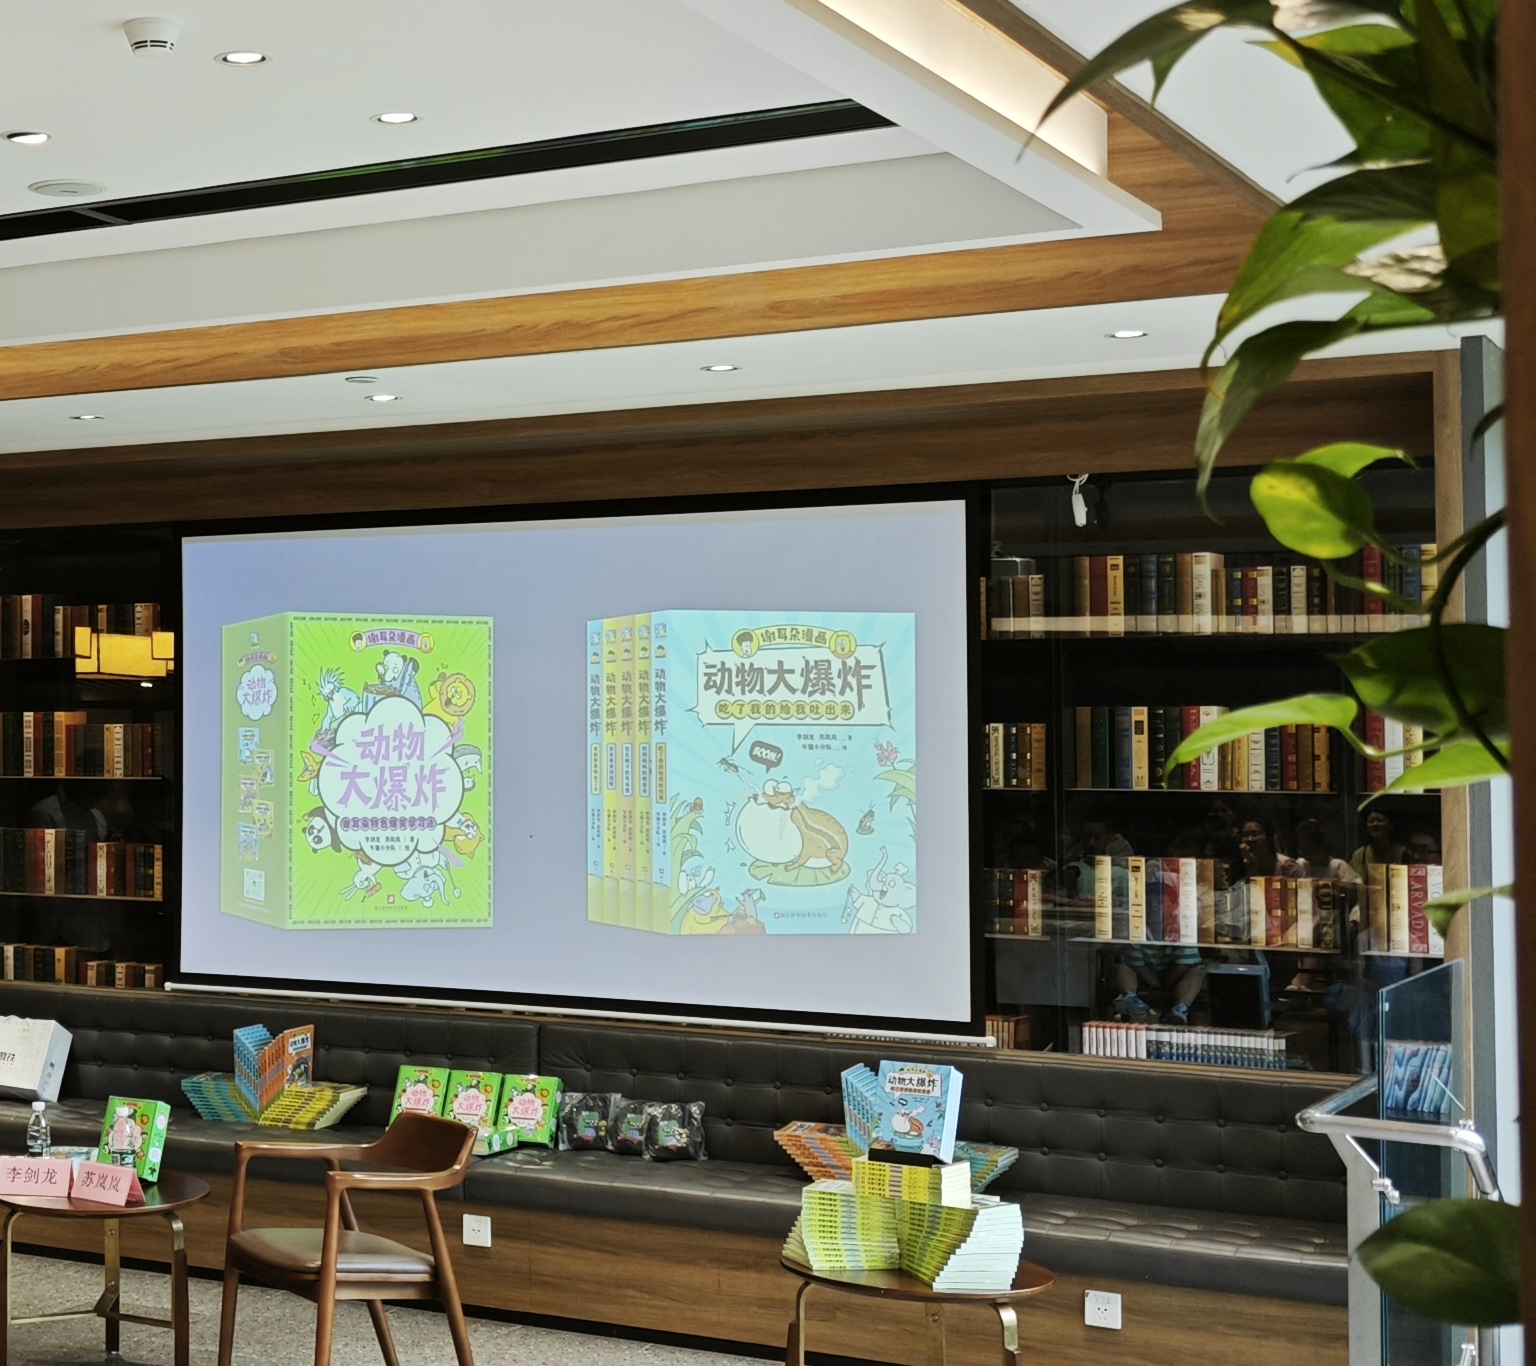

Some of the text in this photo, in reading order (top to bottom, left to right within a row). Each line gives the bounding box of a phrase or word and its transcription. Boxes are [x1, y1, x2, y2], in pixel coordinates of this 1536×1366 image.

[761, 627, 828, 645] 谢耳朵漫画
[703, 656, 877, 712] 动物大爆炸
[718, 702, 852, 717] 吃了我的给我吐出来
[355, 722, 426, 766] 动物
[336, 762, 451, 814] 大爆炸
[888, 1075, 939, 1092] 动物大爆炸
[6, 1166, 58, 1185] 李剑龙
[81, 1170, 122, 1193] 苏岚岚
